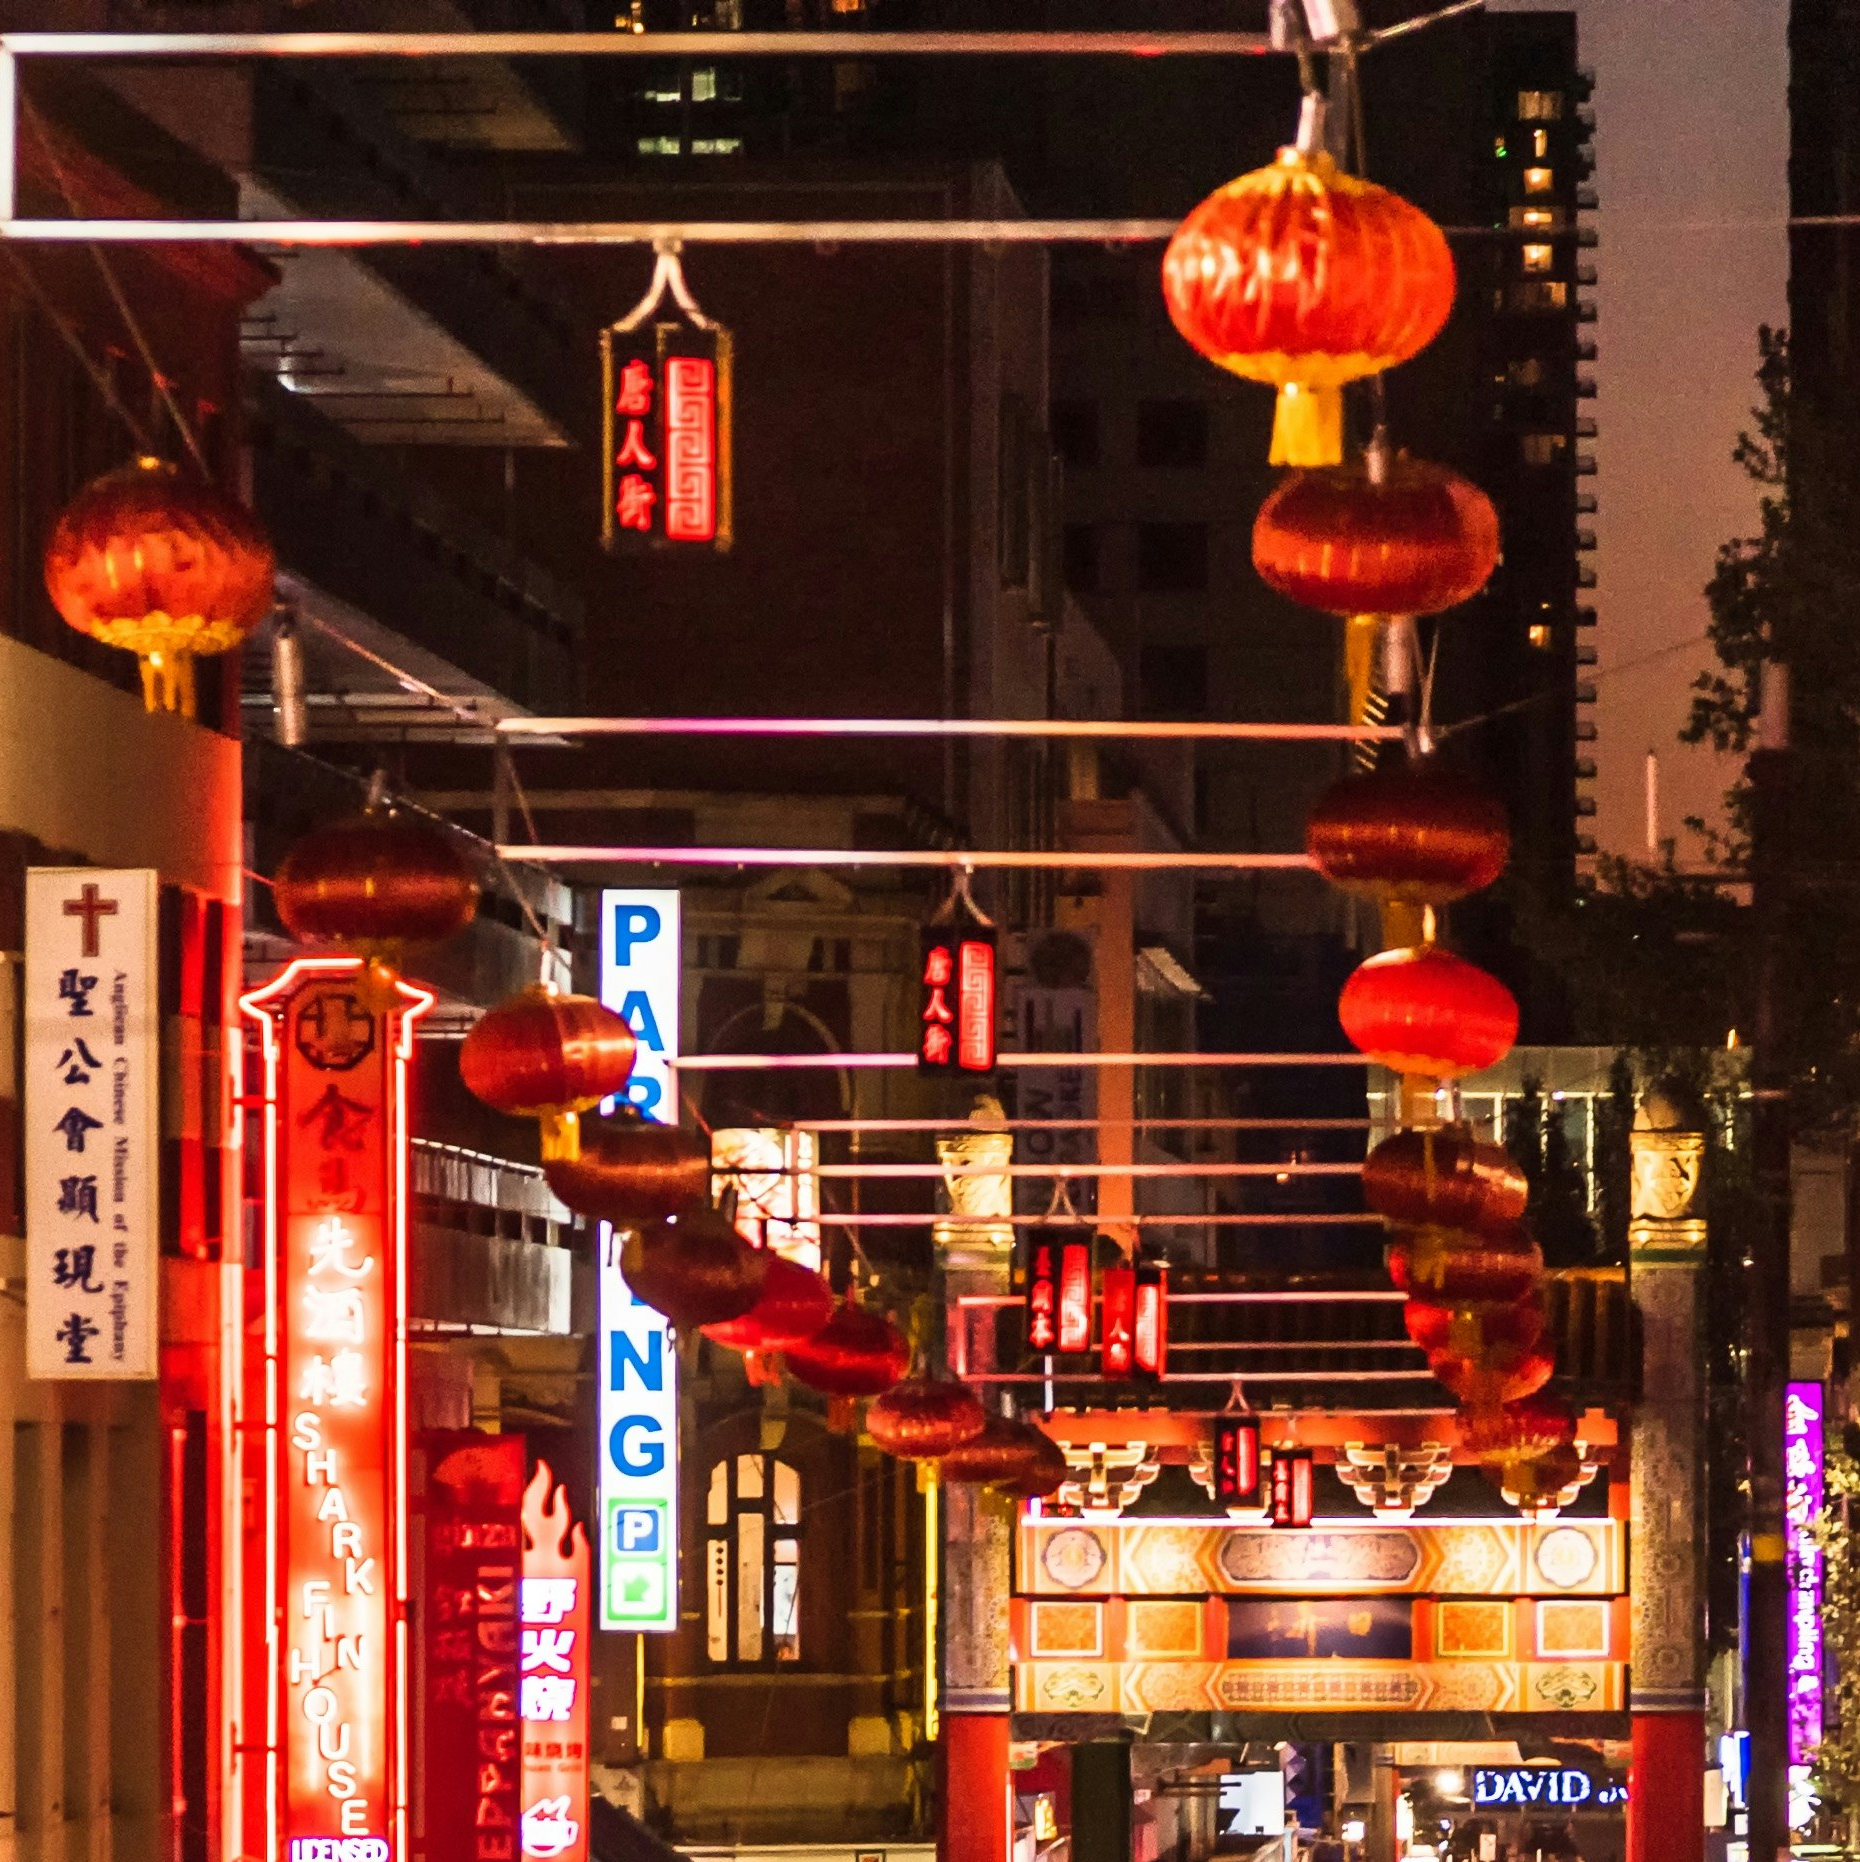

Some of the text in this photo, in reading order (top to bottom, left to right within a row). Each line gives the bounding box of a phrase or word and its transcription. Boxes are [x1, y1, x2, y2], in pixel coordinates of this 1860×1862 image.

[615, 358, 658, 533] 唐人街
[52, 968, 105, 1365] 聖公會顯現堂
[107, 968, 129, 1362] Anglican Chinese Mission of the Epiphany
[292, 1411, 376, 1596] SHARK
[302, 1580, 366, 1671] FIN
[290, 1647, 370, 1836] HOUSE
[1474, 1768, 1591, 1804] DAVID
